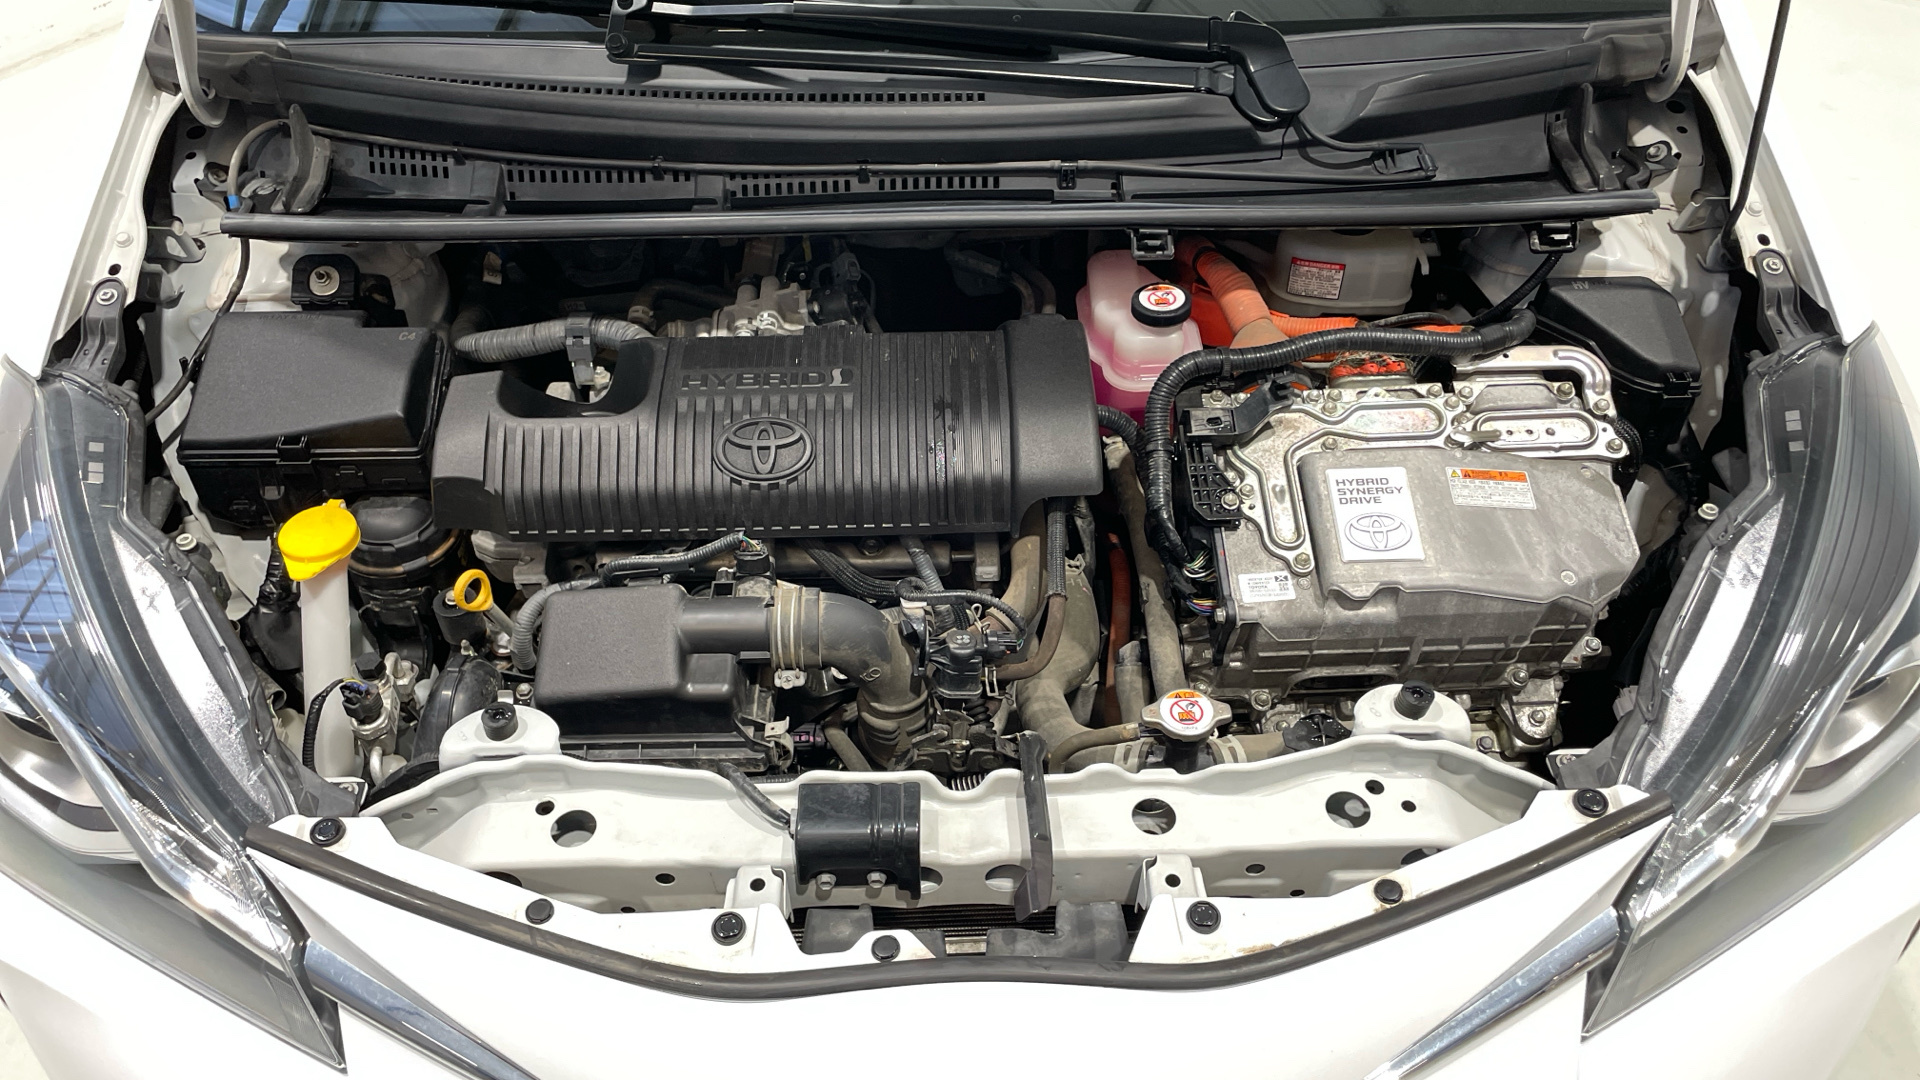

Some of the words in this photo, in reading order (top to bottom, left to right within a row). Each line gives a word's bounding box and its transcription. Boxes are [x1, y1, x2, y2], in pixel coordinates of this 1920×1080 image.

[681, 371, 827, 391] HYBRID
[1335, 477, 1390, 487] HYBRID
[1337, 486, 1404, 496] SYNERGY
[1339, 496, 1383, 505] DRIVE
